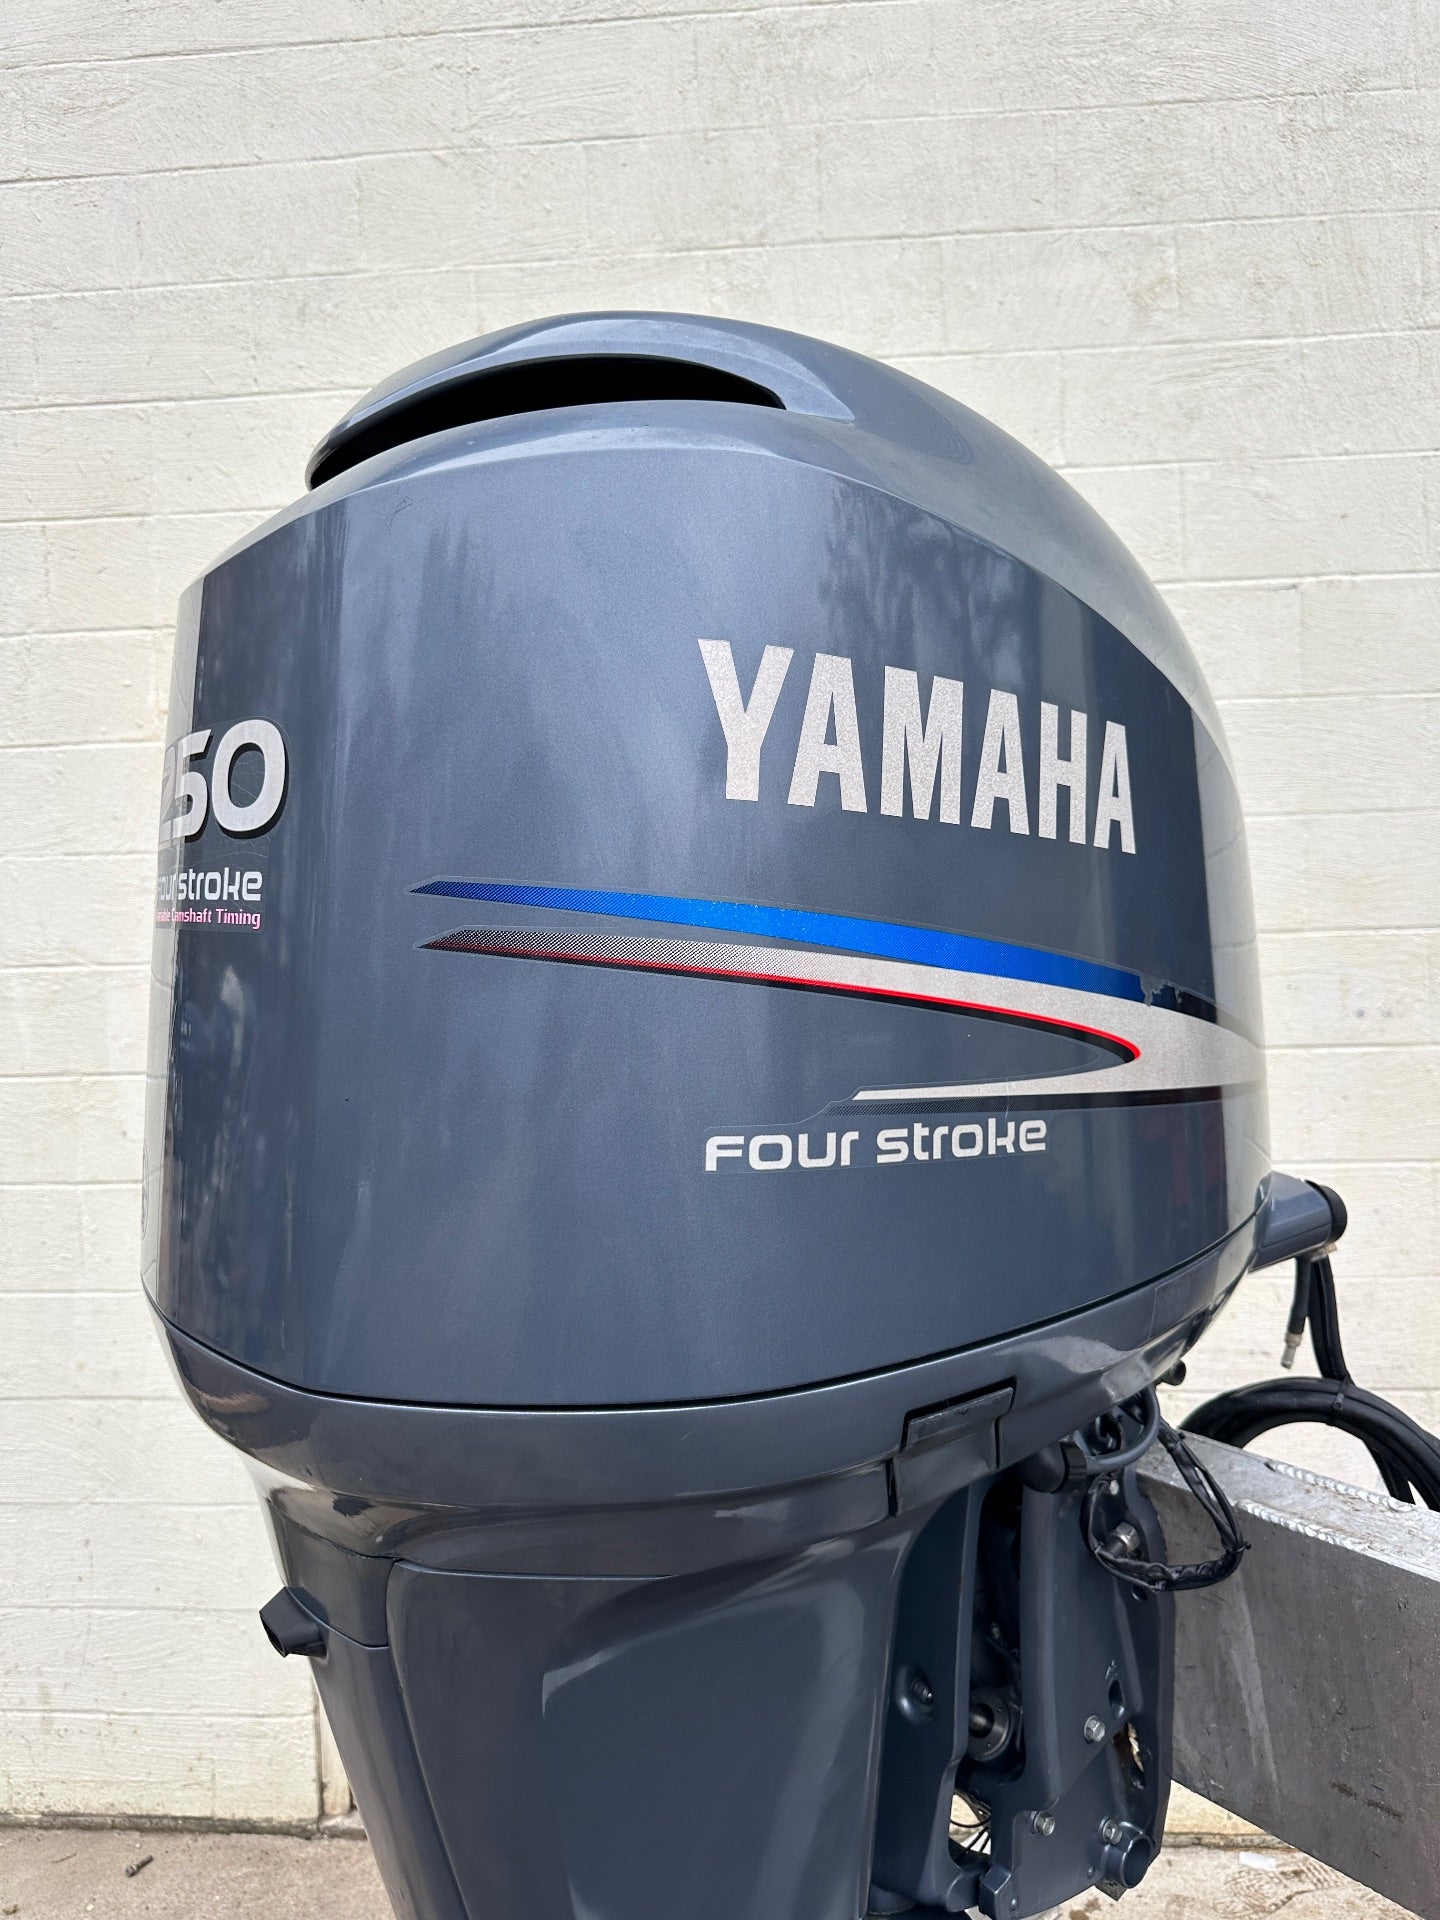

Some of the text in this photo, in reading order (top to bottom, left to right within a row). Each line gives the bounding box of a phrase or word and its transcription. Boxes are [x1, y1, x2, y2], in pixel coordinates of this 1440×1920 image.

[697, 638, 1137, 855] YAMAHA
[178, 866, 263, 901] stroke
[215, 908, 261, 930] Timing
[876, 1117, 1047, 1164] stroke
